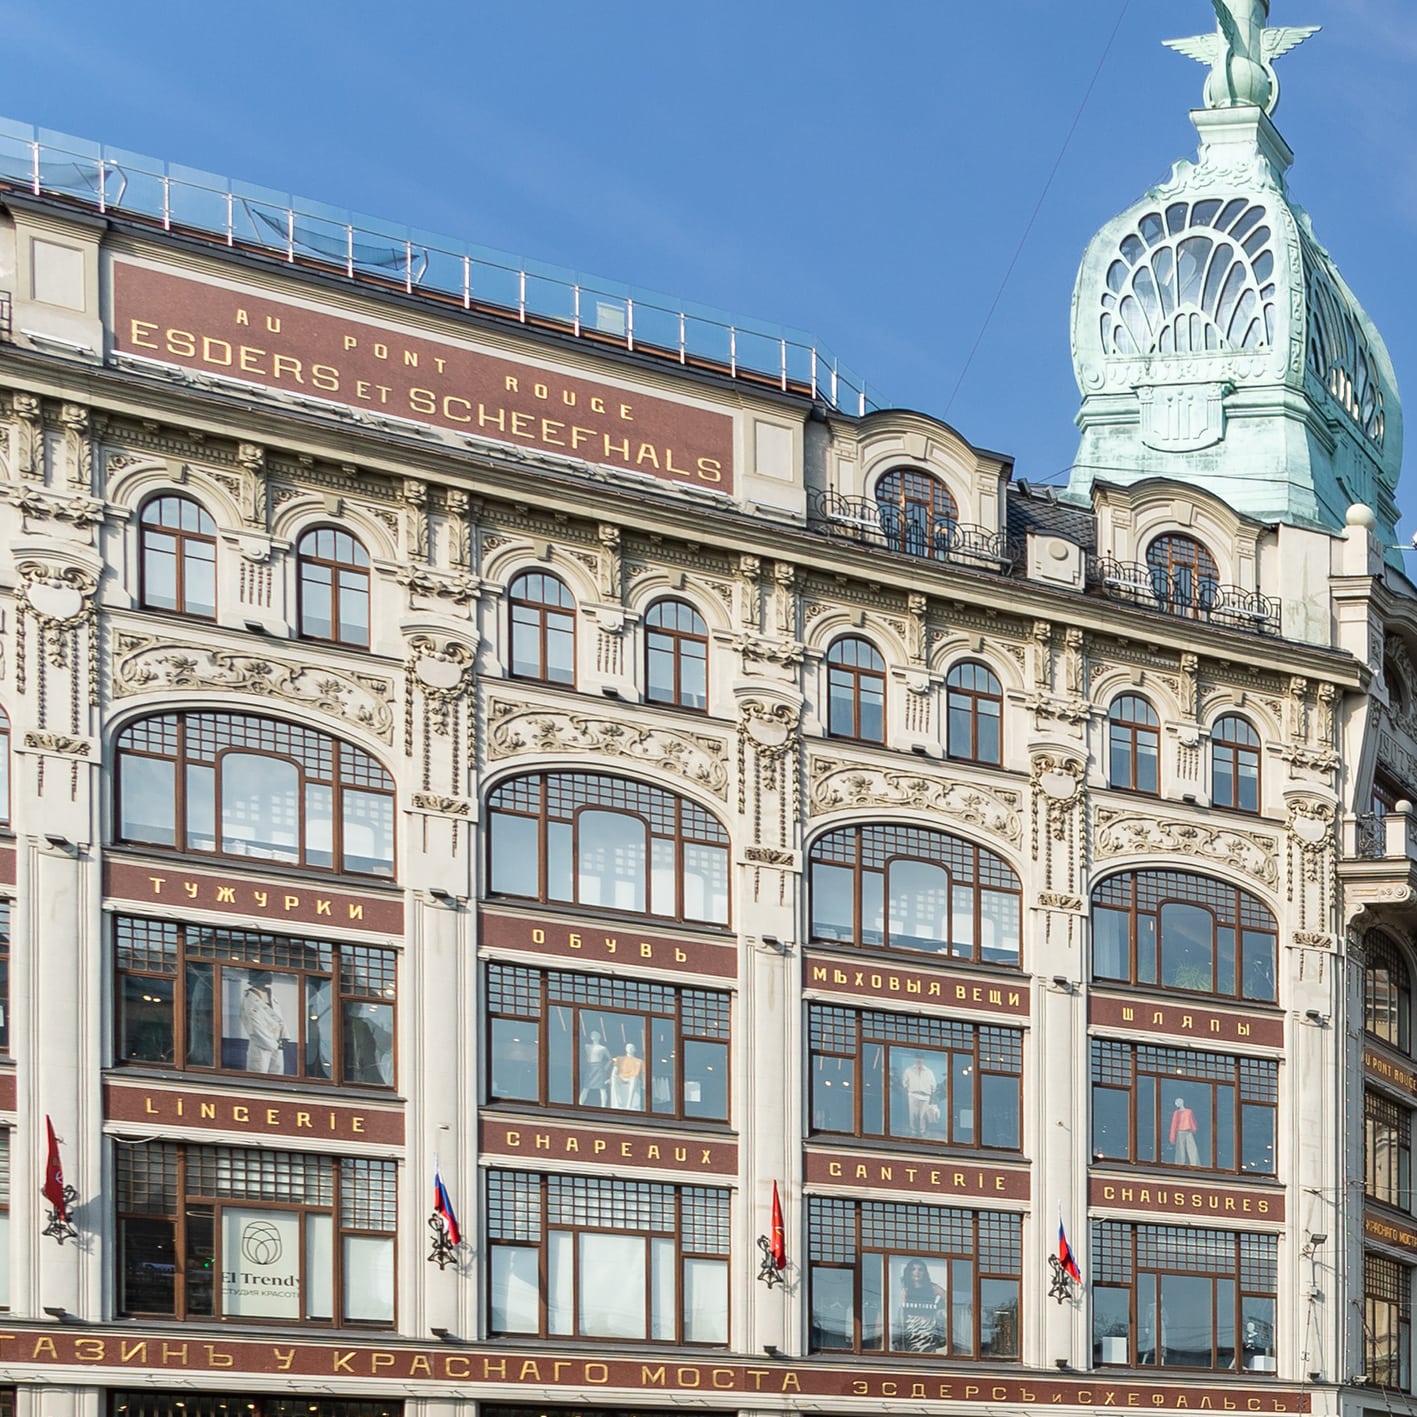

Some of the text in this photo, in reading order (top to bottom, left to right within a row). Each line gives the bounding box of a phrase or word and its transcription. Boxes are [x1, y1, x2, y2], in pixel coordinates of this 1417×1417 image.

[236, 307, 635, 422] AU PONT ROUGE
[129, 318, 723, 484] ESDERS ET SCHEEFHALS
[148, 876, 364, 921] ТУЖУРКИ
[531, 927, 688, 964] ОБУВЬ
[956, 984, 1020, 1008] ВЕЩИ
[1122, 1006, 1251, 1036] ШЛЯПЫ
[505, 1130, 714, 1165] CHAPEAUX
[1104, 1185, 1269, 1214] CHAUSSURES
[274, 1349, 297, 1370] У
[332, 1350, 609, 1384] КРАСНАГО
[641, 1363, 801, 1395] МОСТА
[853, 1381, 1036, 1403] ЭСДЕРСЪ
[1078, 1391, 1287, 1413] СХЕФАЛЬСЪ
